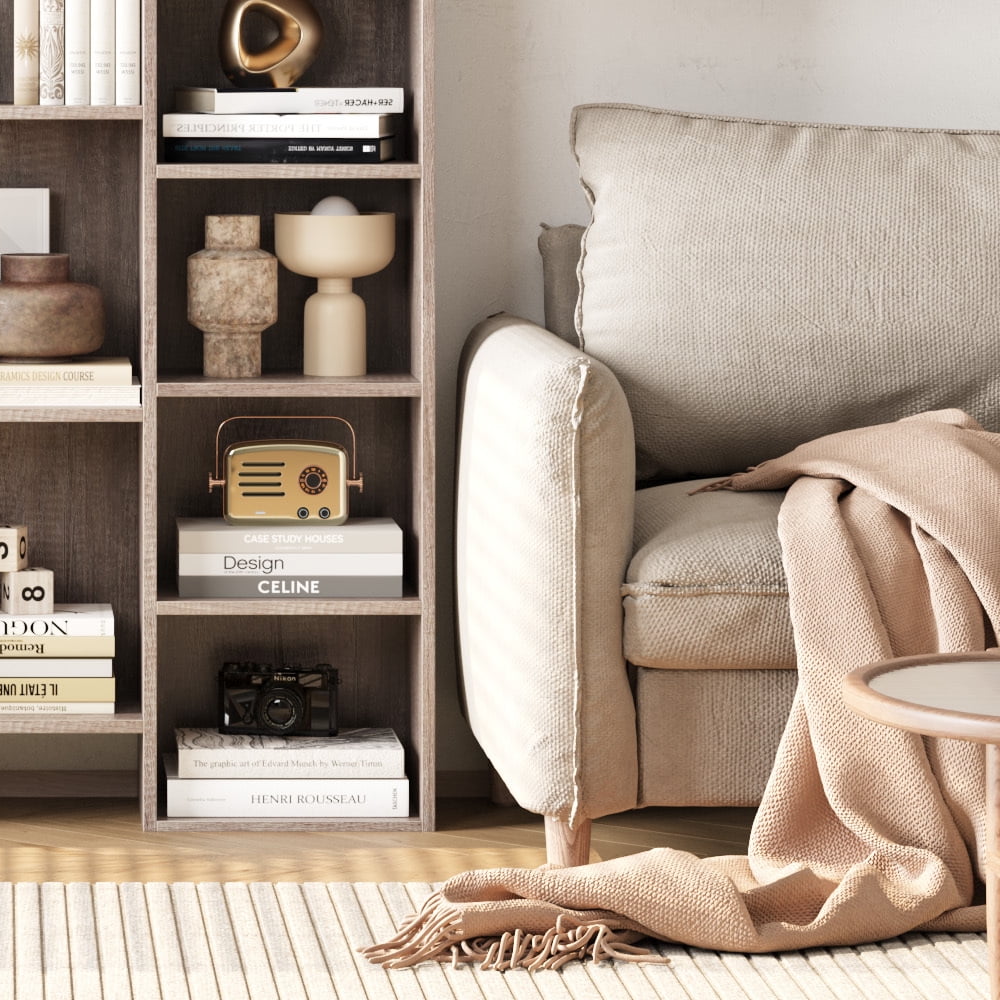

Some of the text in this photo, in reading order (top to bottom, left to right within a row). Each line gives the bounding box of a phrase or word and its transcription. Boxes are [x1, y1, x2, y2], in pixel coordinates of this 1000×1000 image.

[32, 371, 61, 381] DESIGN
[63, 371, 94, 381] COURSE
[244, 535, 344, 544] CASE STUDY HOUSES
[224, 555, 284, 574] Design
[258, 581, 320, 594] CELINE
[22, 586, 45, 602] 8
[20, 684, 47, 699] ÉTAIT
[49, 684, 58, 695] IL
[193, 760, 208, 768] The
[209, 760, 237, 770] graphic
[251, 760, 261, 768] of
[262, 760, 289, 768] Edvard
[319, 760, 329, 770] by
[331, 760, 358, 768] Werner
[251, 795, 367, 804] HENRI ROUSSEAU
